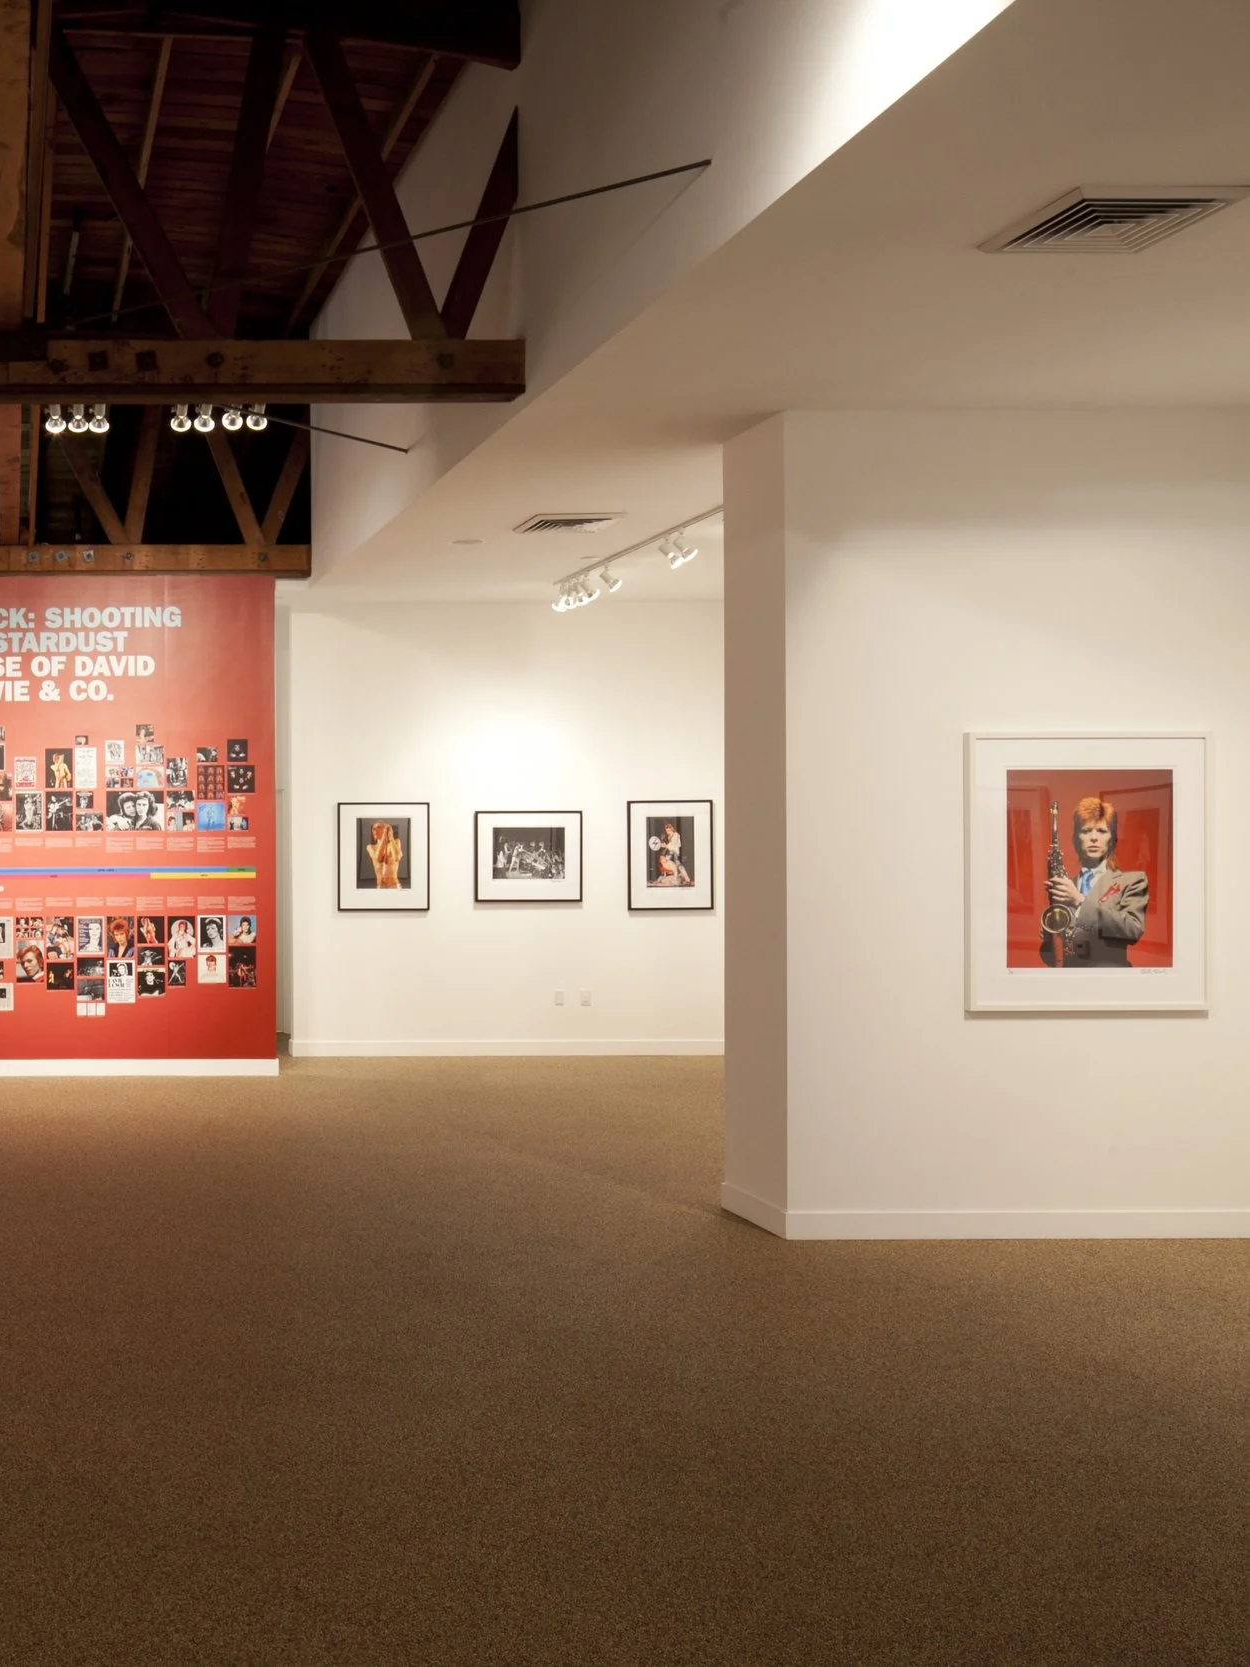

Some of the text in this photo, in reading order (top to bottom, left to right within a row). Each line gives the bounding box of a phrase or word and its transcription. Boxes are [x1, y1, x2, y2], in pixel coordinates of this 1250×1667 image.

[45, 606, 182, 628] SHOOTING
[31, 655, 66, 677] OF
[75, 655, 155, 677] DAVID
[39, 680, 60, 702] &
[69, 679, 114, 701] CO.
